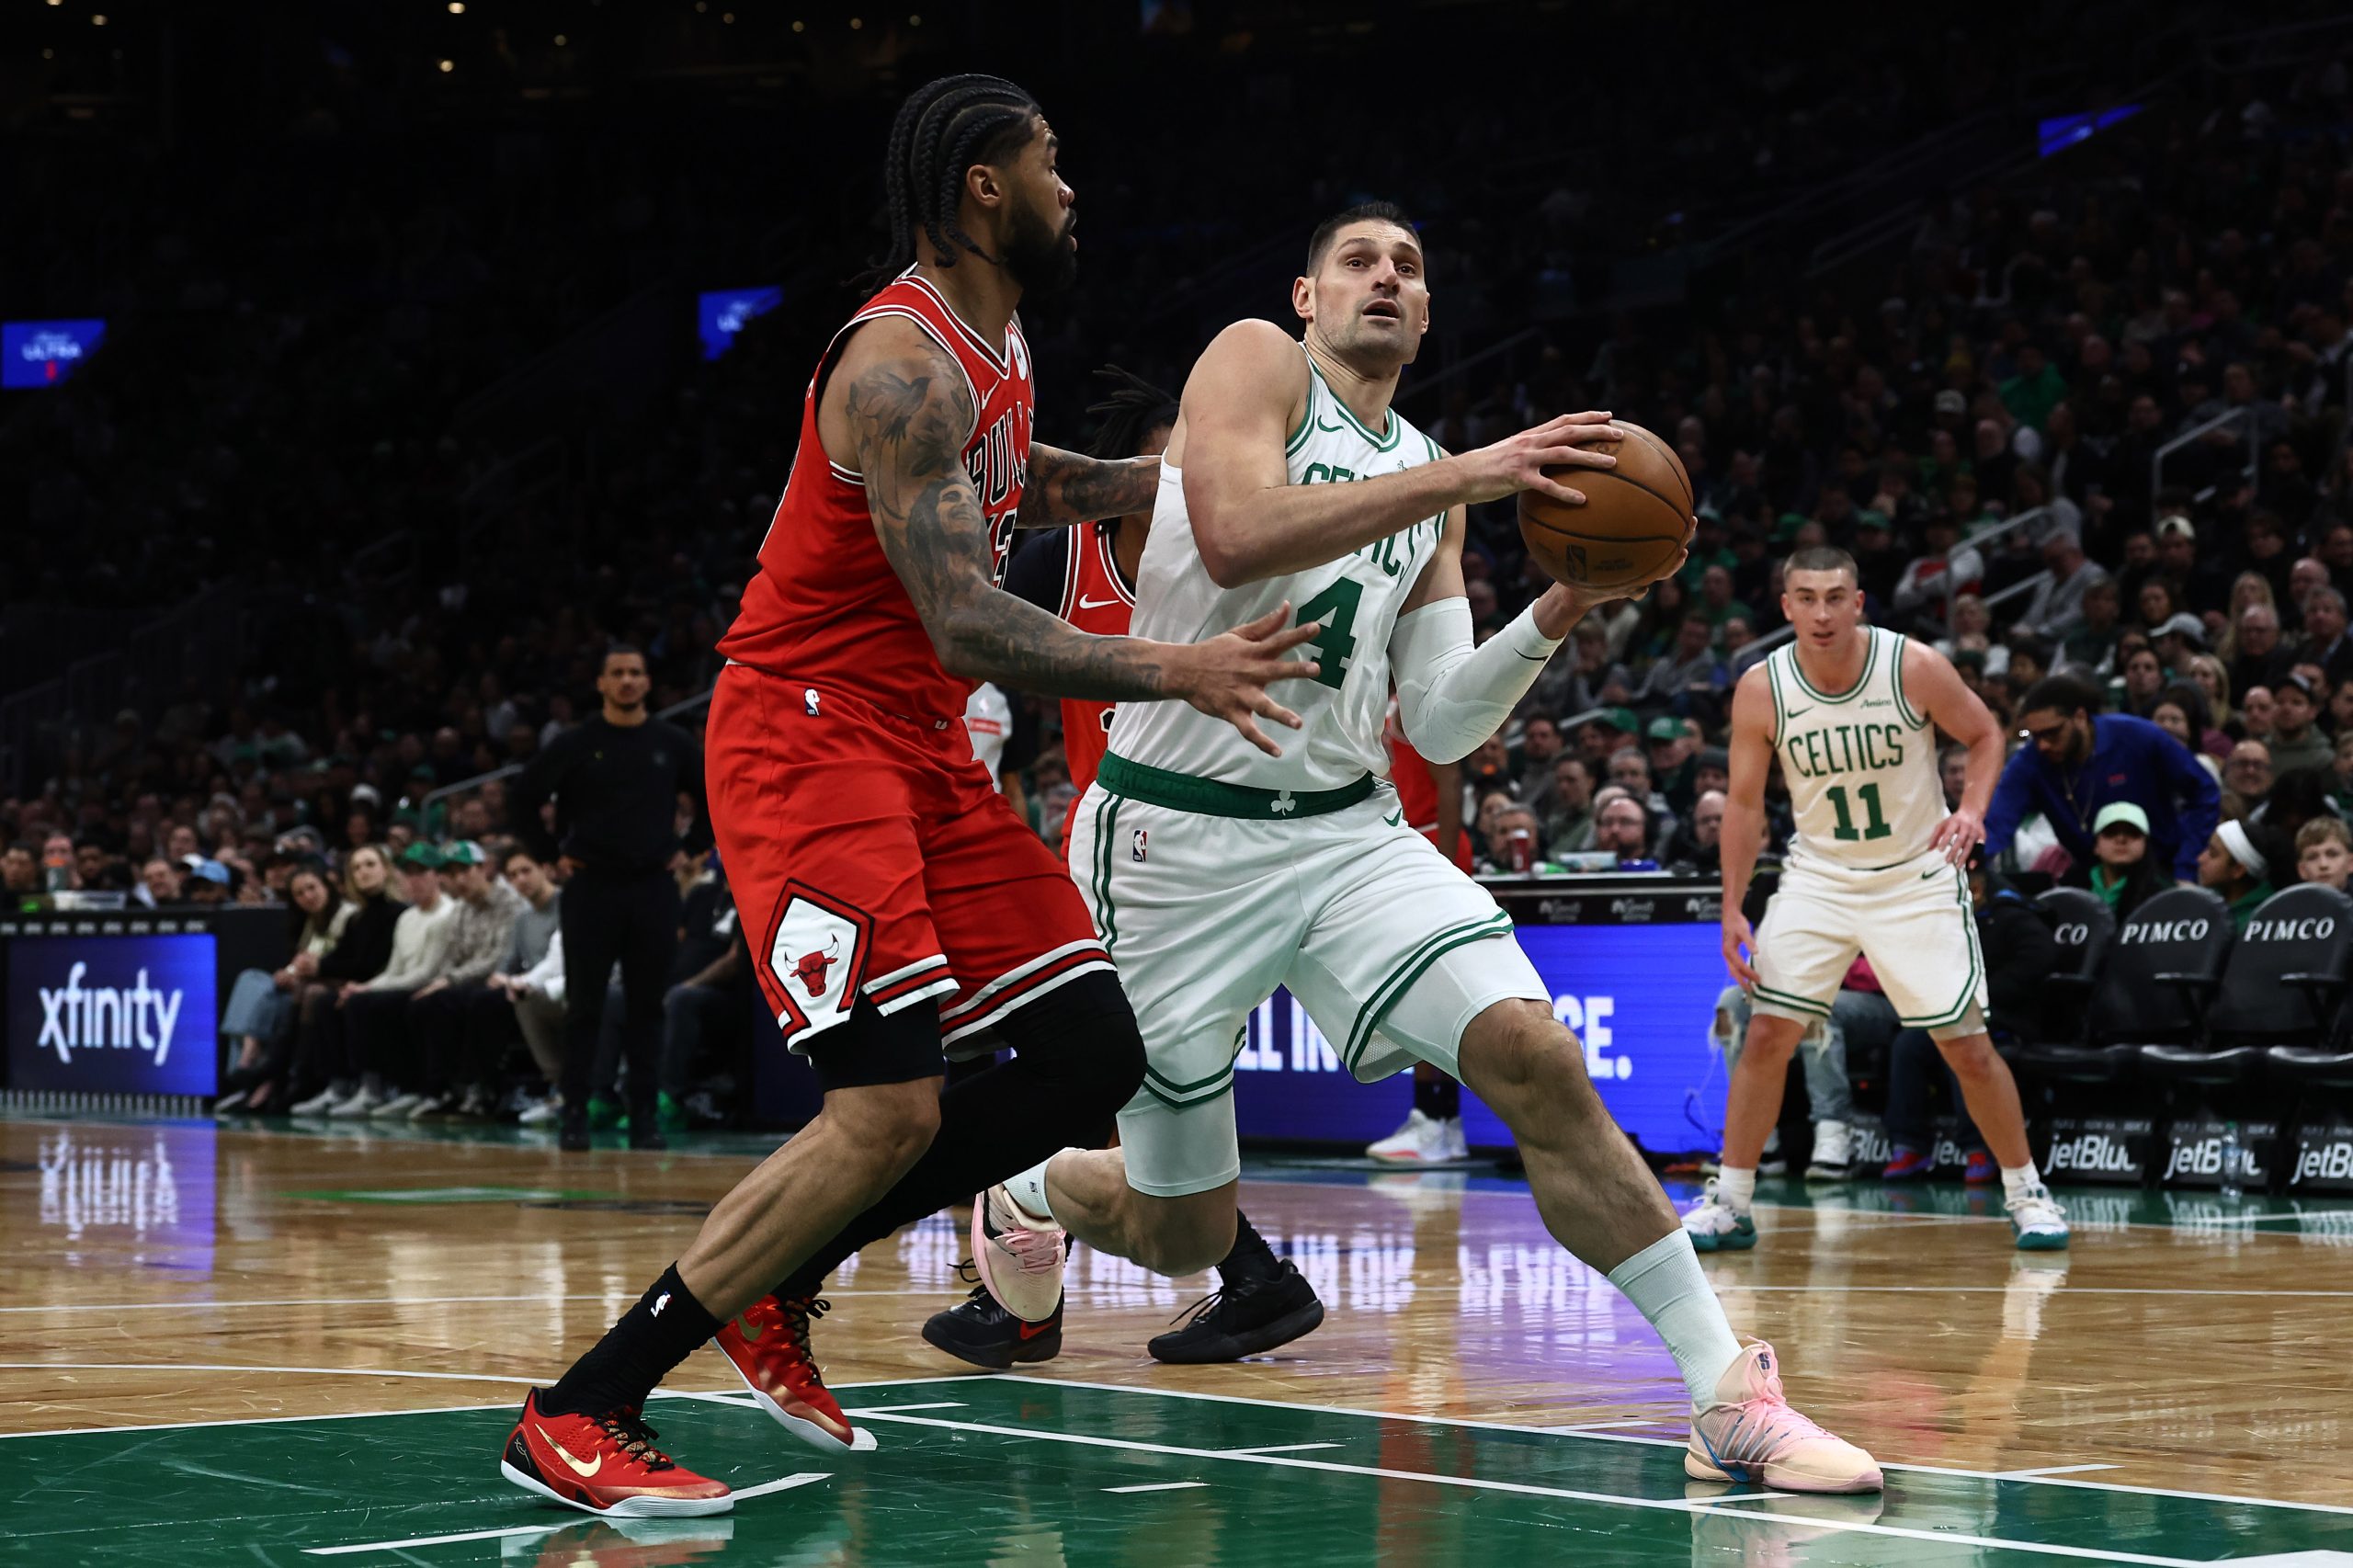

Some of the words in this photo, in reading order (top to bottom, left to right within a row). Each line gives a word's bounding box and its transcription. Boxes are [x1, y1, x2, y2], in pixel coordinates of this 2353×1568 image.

[1295, 576, 1364, 690] 4
[1788, 723, 1904, 778] CELTICS
[1826, 783, 1893, 841] 11
[2120, 918, 2210, 945] PIMCO
[2243, 916, 2336, 942] PIMCO
[38, 960, 183, 1067] xfinity
